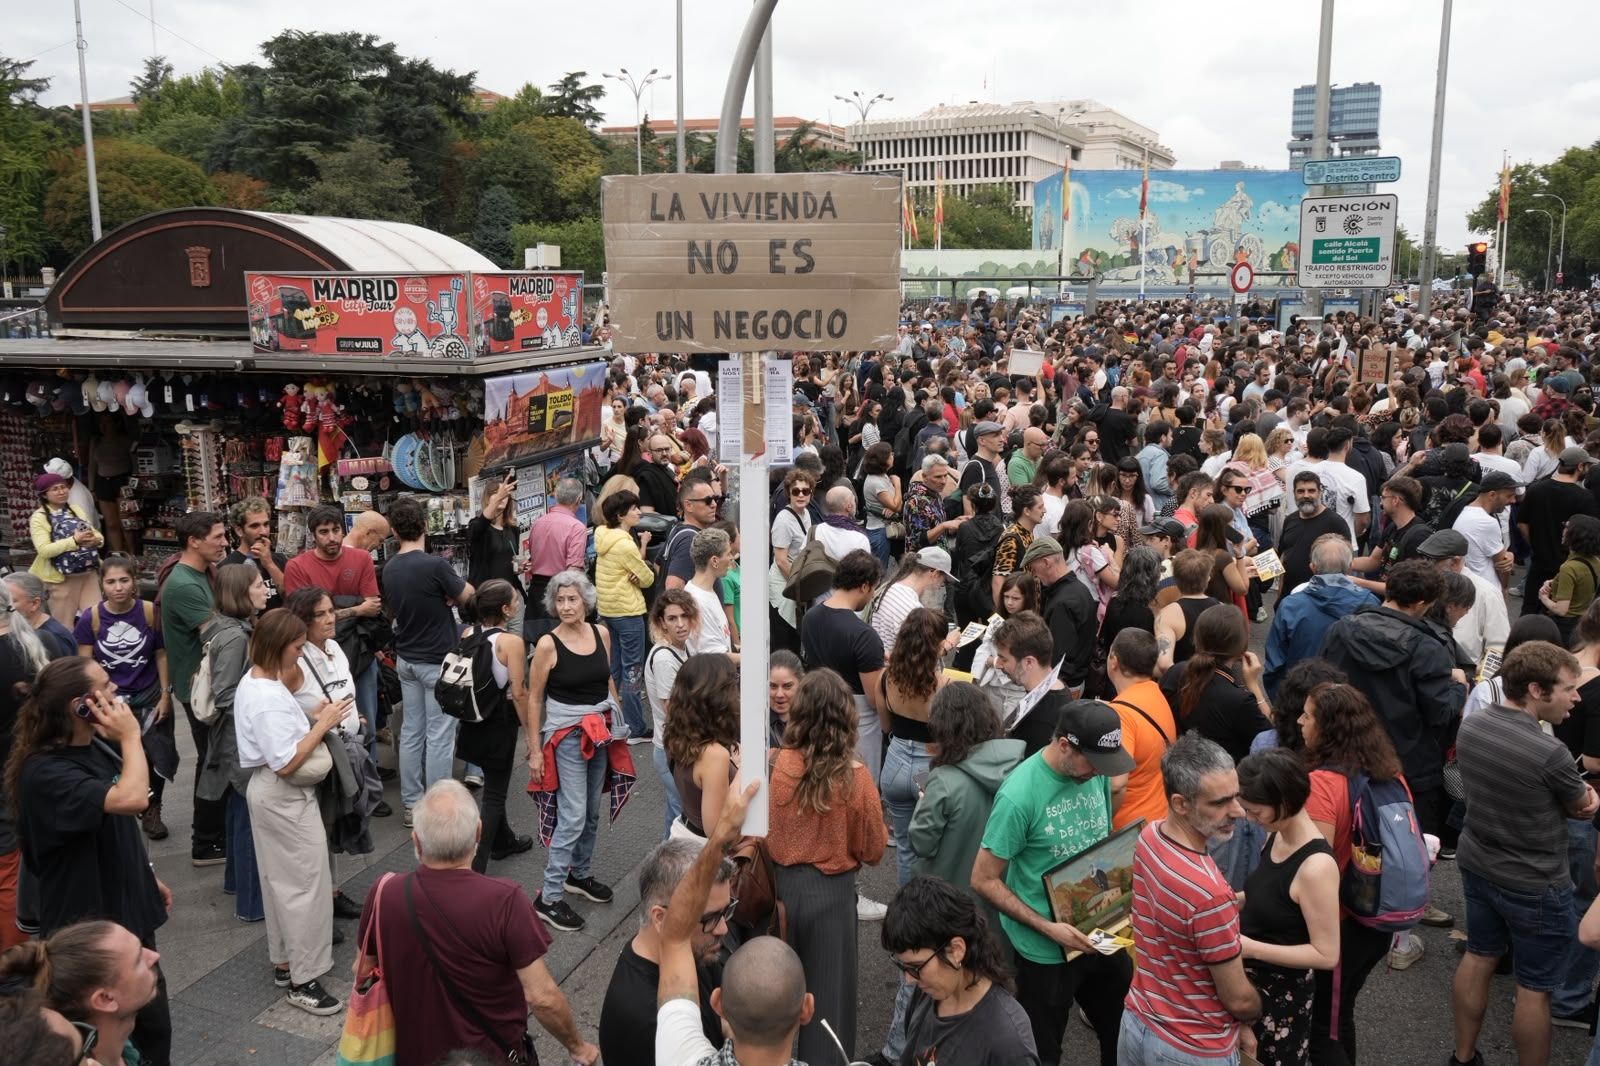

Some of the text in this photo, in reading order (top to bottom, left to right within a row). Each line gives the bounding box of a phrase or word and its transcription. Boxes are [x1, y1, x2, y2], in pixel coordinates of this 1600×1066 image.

[1325, 172, 1396, 182] Distrito Centro
[650, 191, 838, 221] LA VIVIENDA
[1308, 201, 1390, 213] ATENCIÓN
[687, 238, 815, 275] NO ES
[312, 278, 398, 301] MADRID
[509, 278, 554, 297] MADRID
[343, 299, 394, 314] City Tour
[302, 317, 320, 330] hop
[655, 308, 848, 341] UN NEGOCIO
[549, 393, 572, 405] TOLEDO
[1046, 797, 1080, 818] ESCUELA
[1059, 825, 1073, 839] DE
